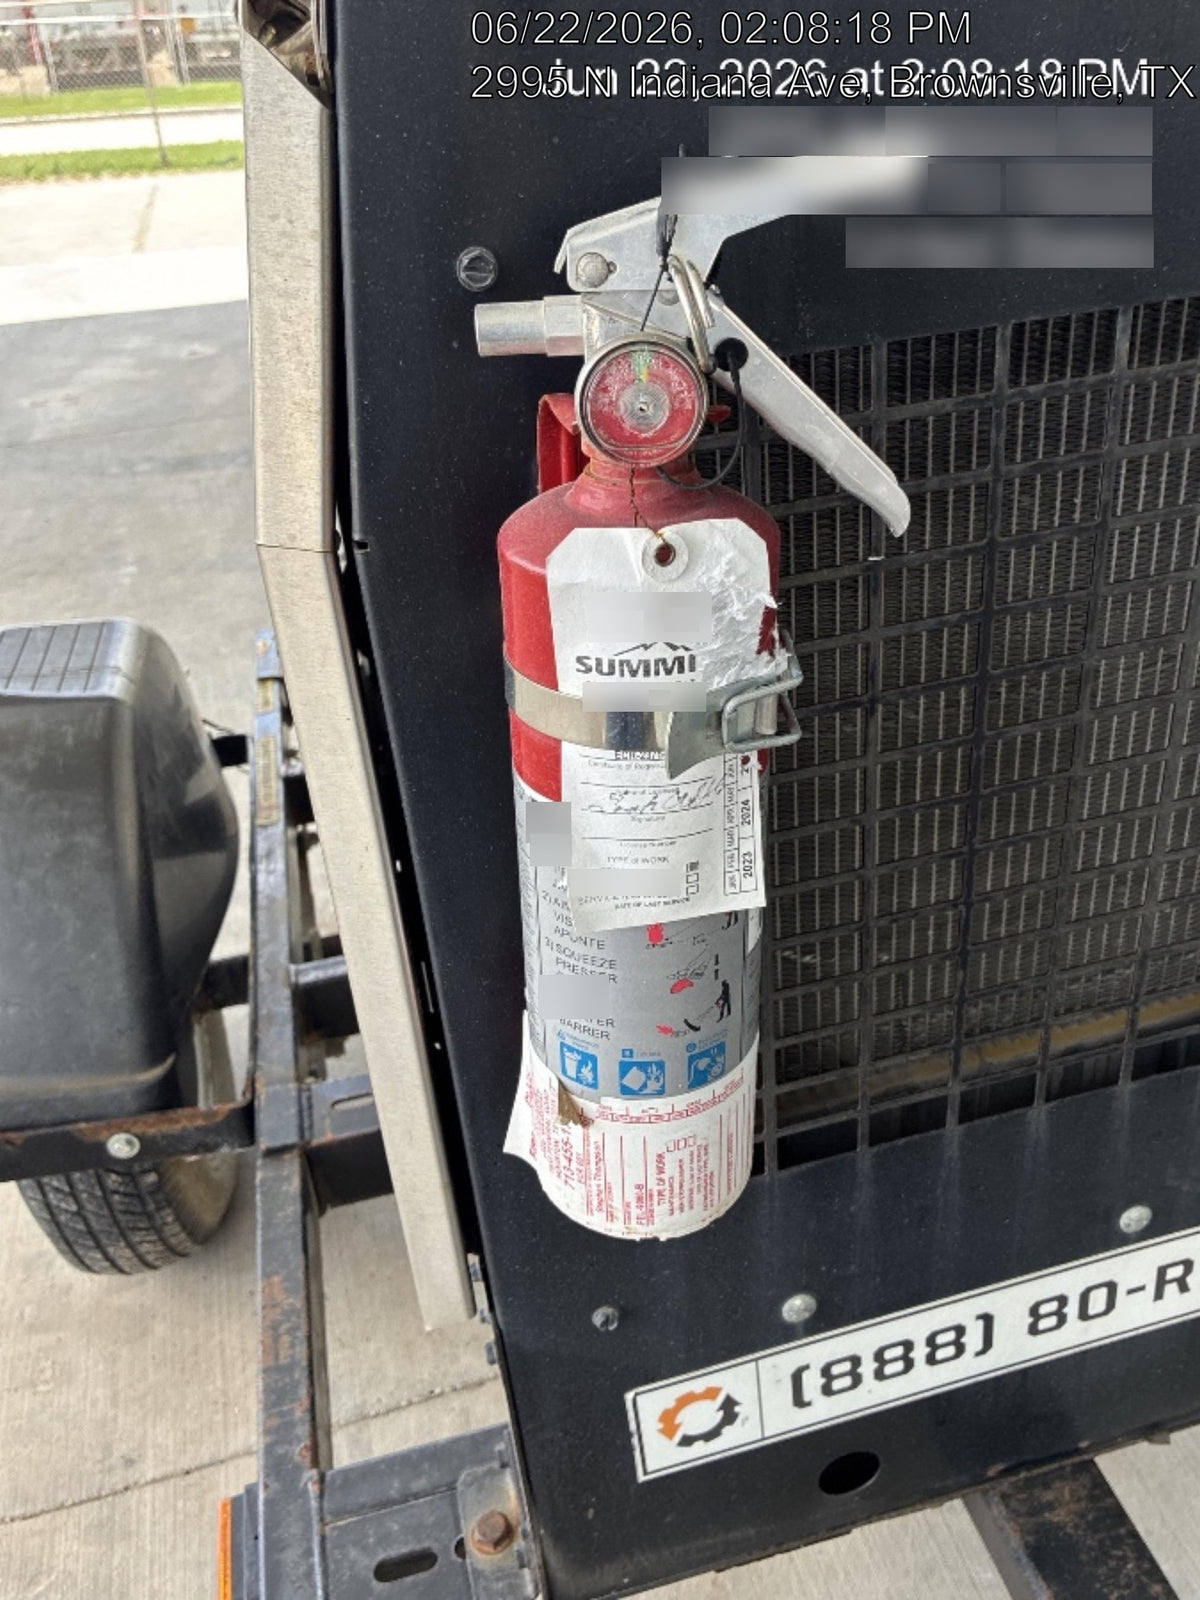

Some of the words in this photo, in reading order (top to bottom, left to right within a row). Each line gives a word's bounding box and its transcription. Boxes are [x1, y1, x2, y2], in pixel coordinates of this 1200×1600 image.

[575, 654, 697, 678] SUMMI
[742, 851, 753, 879] 2023
[791, 1311, 995, 1410] (888)
[1027, 1258, 1195, 1337] 80-R
